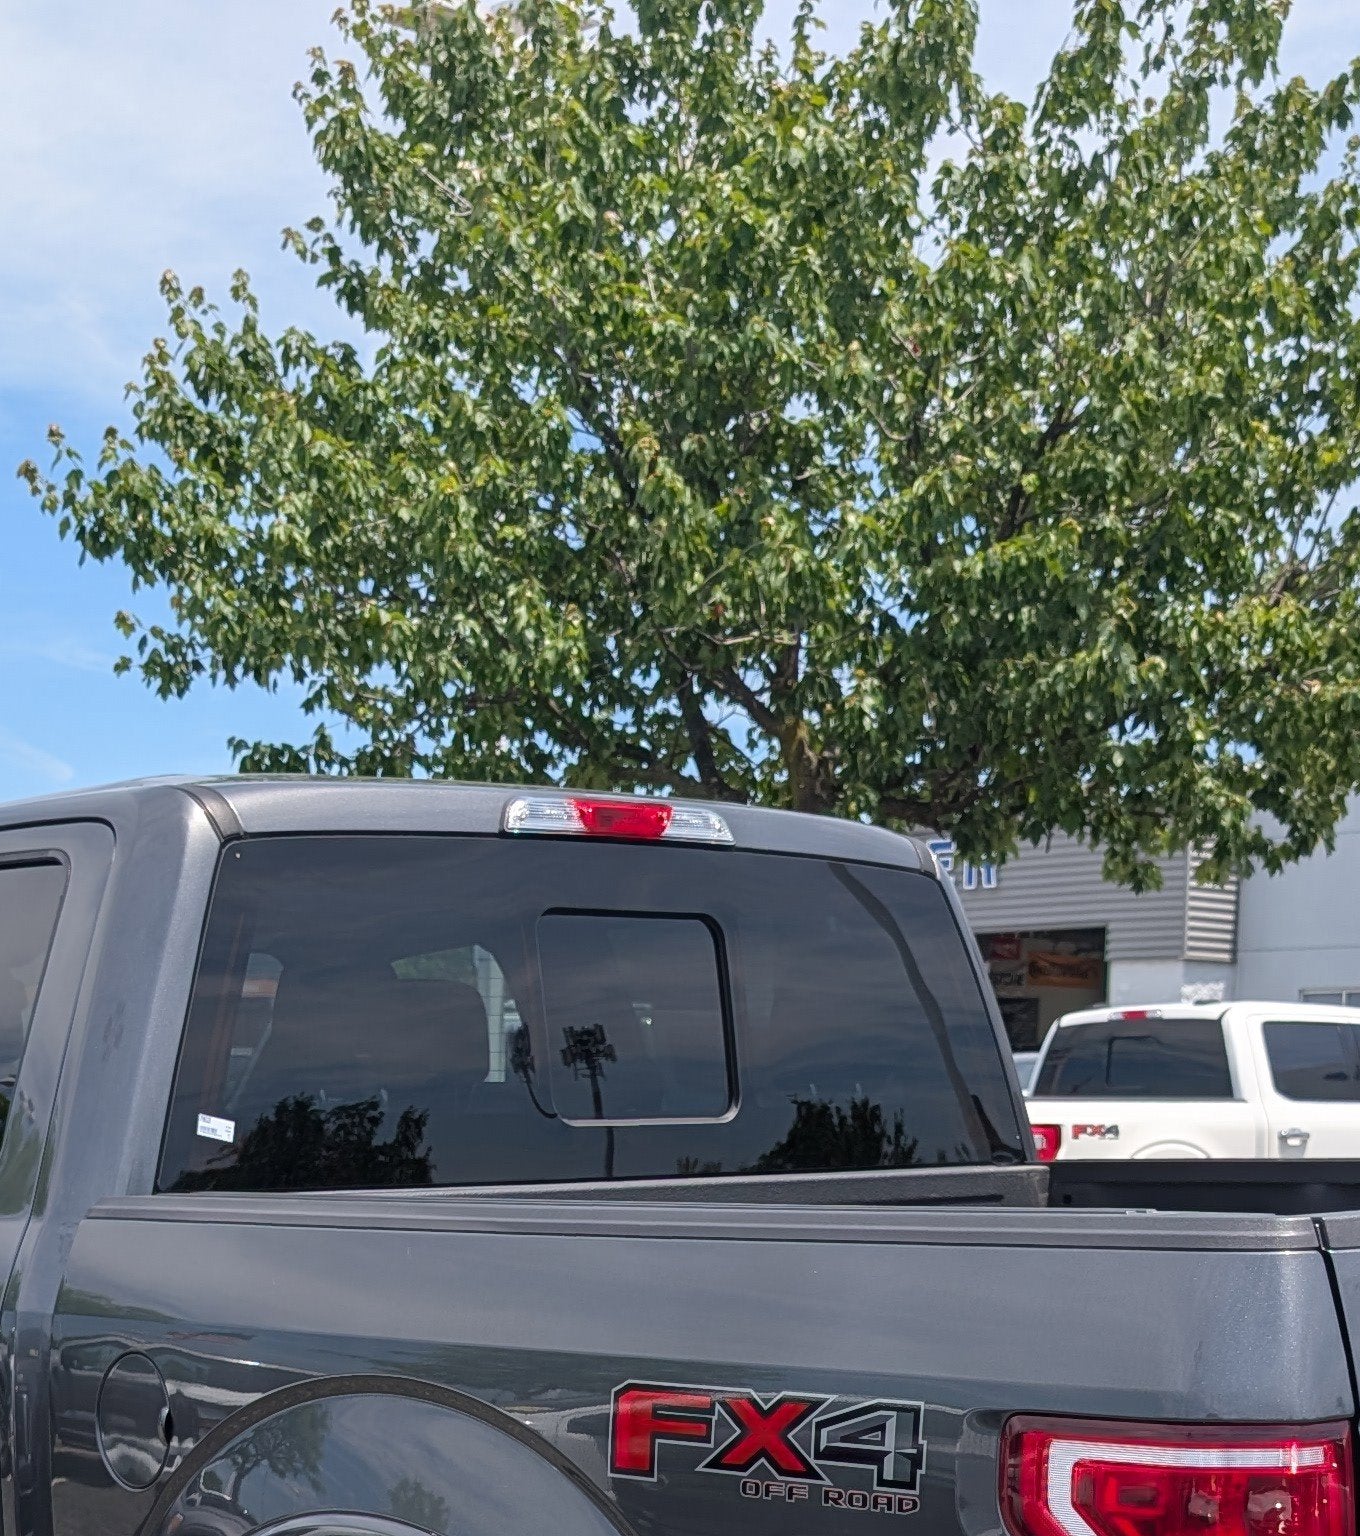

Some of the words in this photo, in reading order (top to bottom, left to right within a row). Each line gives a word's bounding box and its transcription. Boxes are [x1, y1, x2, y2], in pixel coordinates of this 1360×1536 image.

[1071, 1124, 1119, 1140] FX4
[607, 1379, 927, 1495] FX4
[741, 1478, 808, 1503] OFF
[822, 1486, 919, 1514] ROAD
